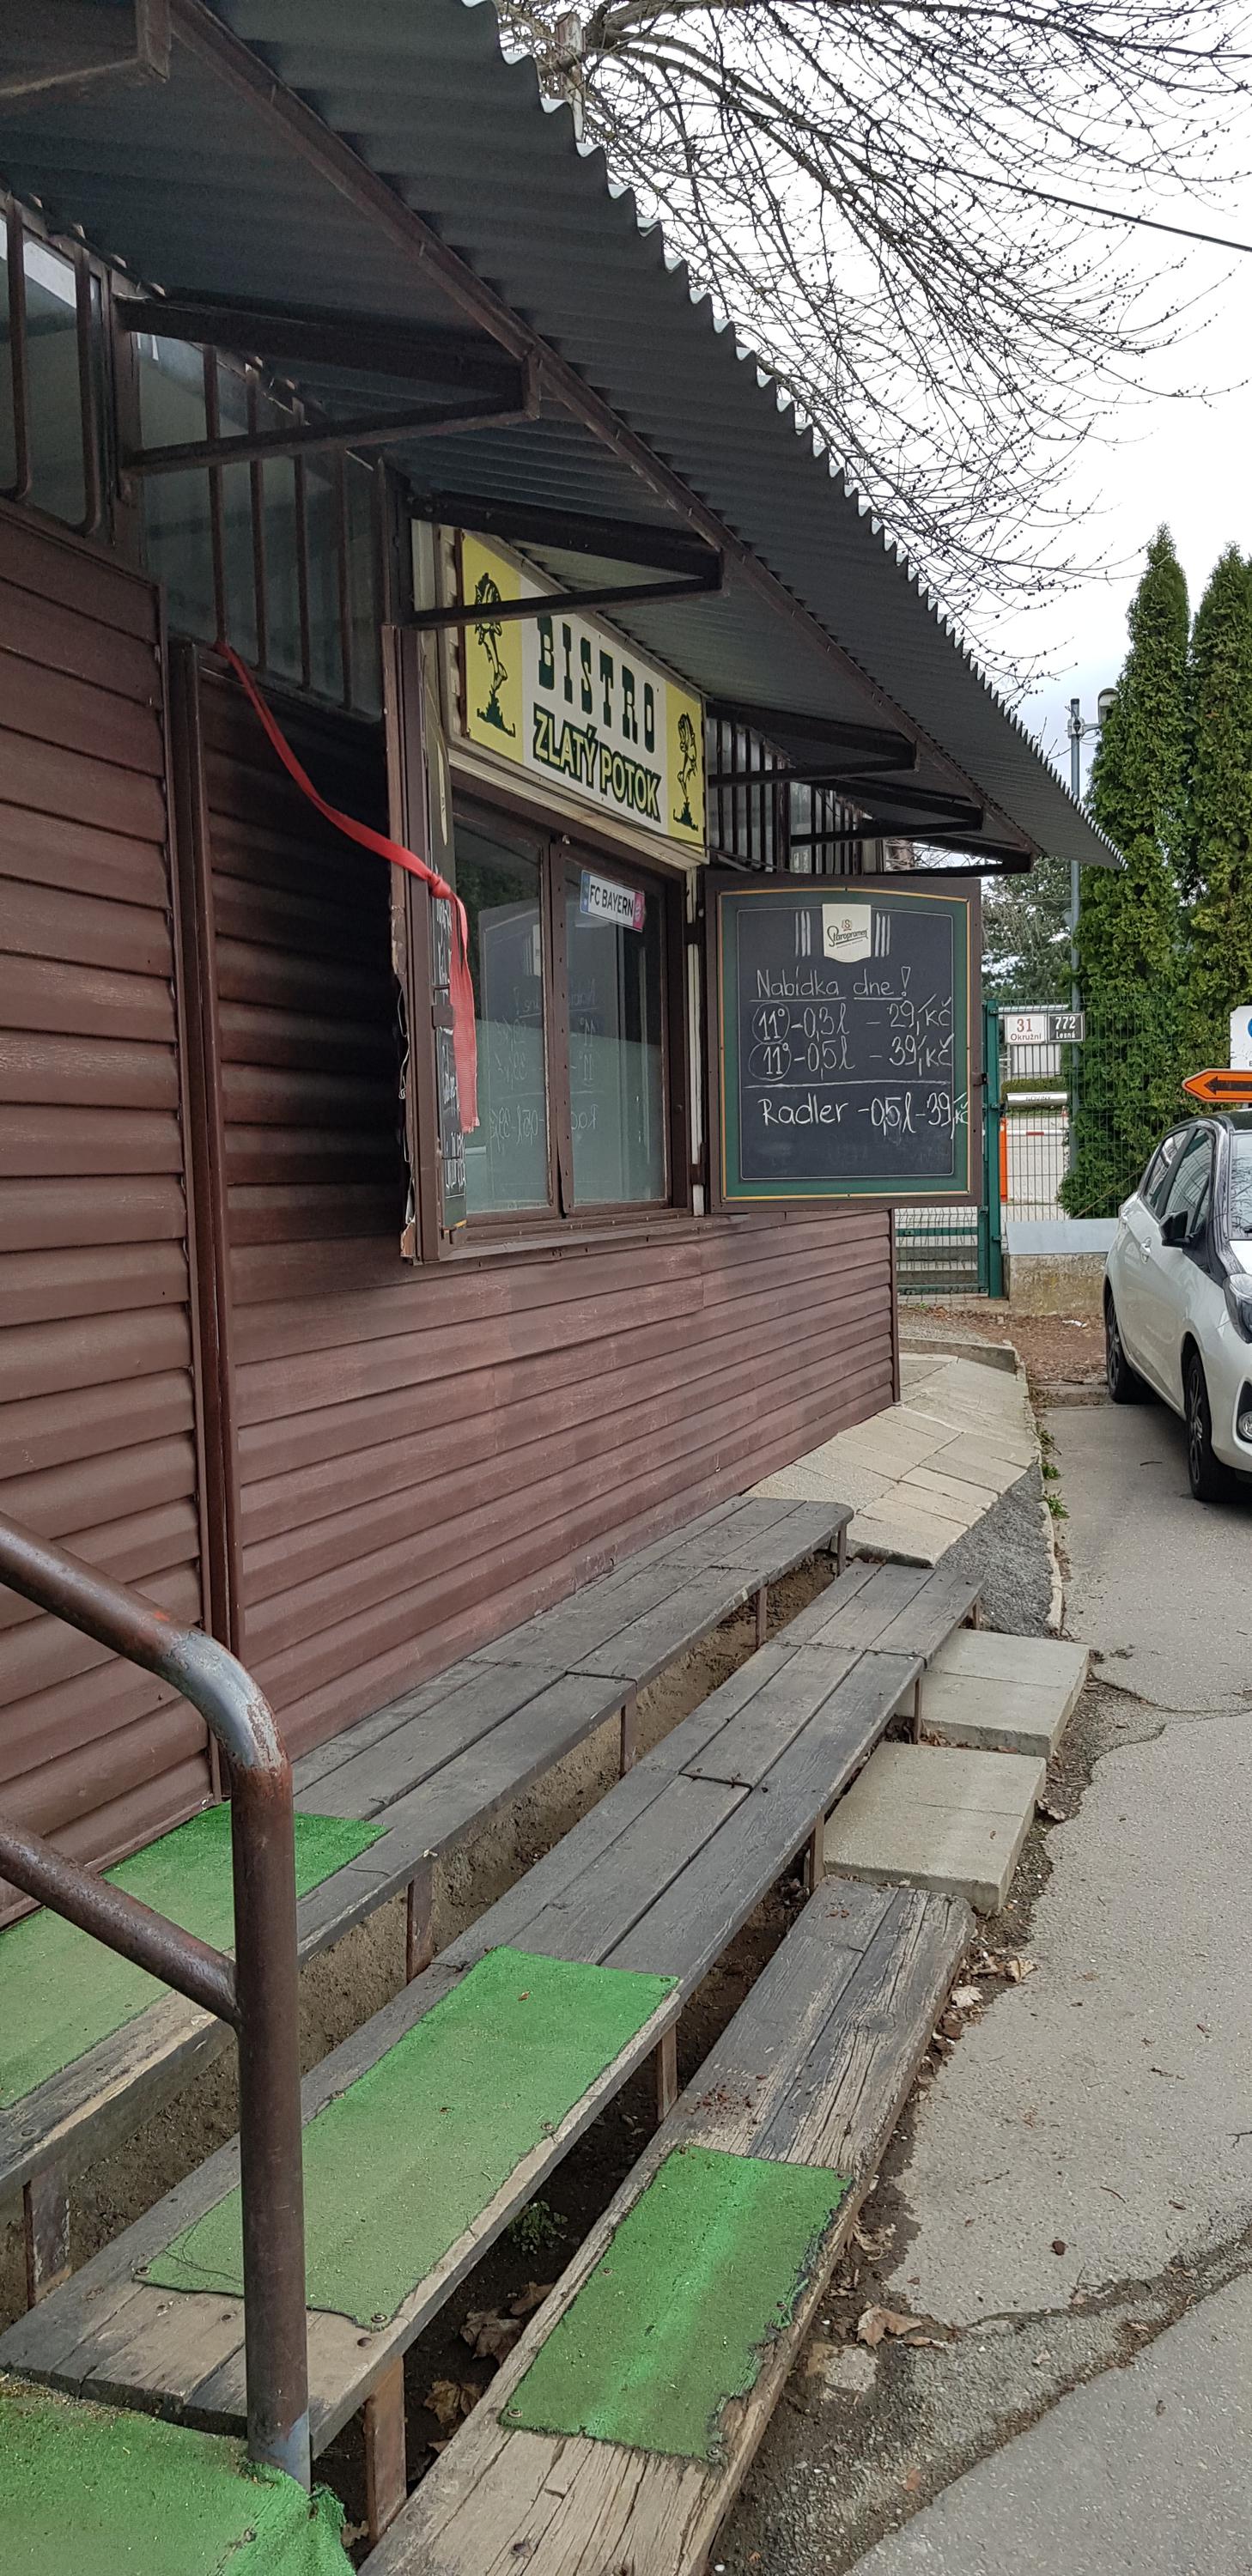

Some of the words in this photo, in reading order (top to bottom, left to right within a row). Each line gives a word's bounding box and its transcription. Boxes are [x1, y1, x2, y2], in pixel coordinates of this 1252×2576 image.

[538, 615, 654, 754] BISTRO
[533, 702, 599, 791] ZLATÝ
[599, 745, 661, 823] POTOK
[590, 884, 601, 906] FC
[601, 888, 634, 918] BAYERN
[757, 966, 840, 998] Nabídka
[1010, 1033, 1042, 1042] Okružní
[1016, 1018, 1032, 1032] 31
[1055, 1016, 1076, 1030] 772
[1055, 1030, 1076, 1039] Lesná
[757, 1092, 849, 1127] Radler
